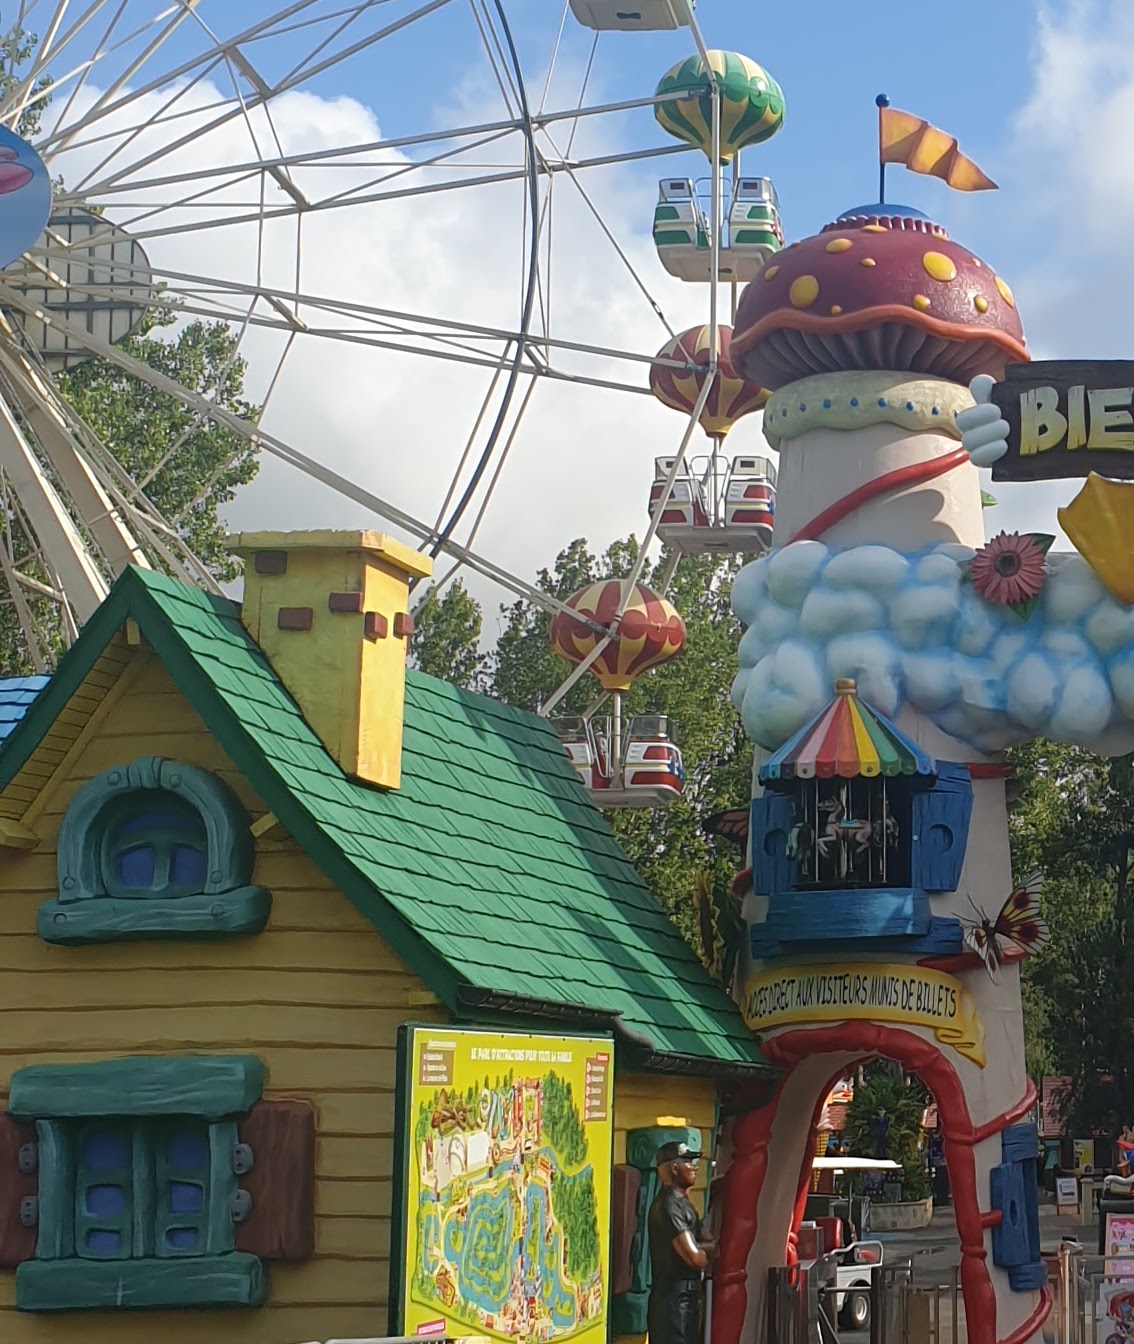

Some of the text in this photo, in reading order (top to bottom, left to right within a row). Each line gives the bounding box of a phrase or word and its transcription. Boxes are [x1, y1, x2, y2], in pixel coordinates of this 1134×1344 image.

[768, 979, 796, 1015] DIRECT
[796, 976, 815, 1007] AUX
[816, 973, 868, 1006] VISITEURS
[869, 975, 899, 1007] MUNIS
[901, 979, 916, 1011] DE
[916, 981, 957, 1017] BILLETS
